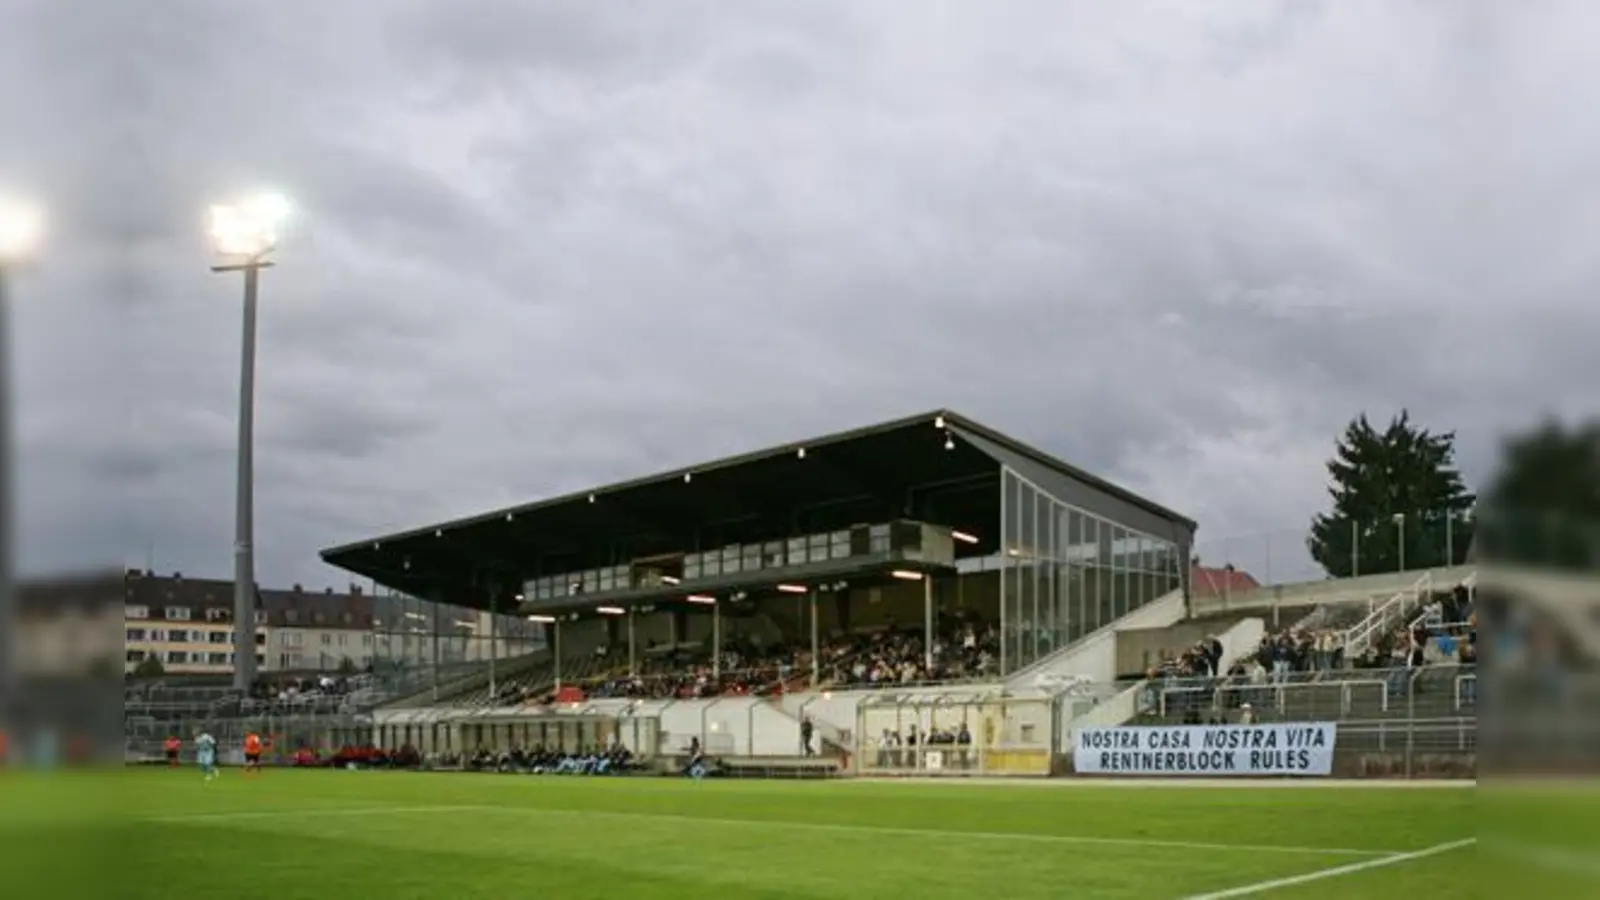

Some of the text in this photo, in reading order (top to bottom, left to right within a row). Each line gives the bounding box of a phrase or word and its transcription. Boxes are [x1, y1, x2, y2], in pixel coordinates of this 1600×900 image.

[1081, 727, 1325, 749] NOSTRA CASA NOSTRA VITA
[1101, 750, 1310, 770] RENTNERBLOCK RULES
